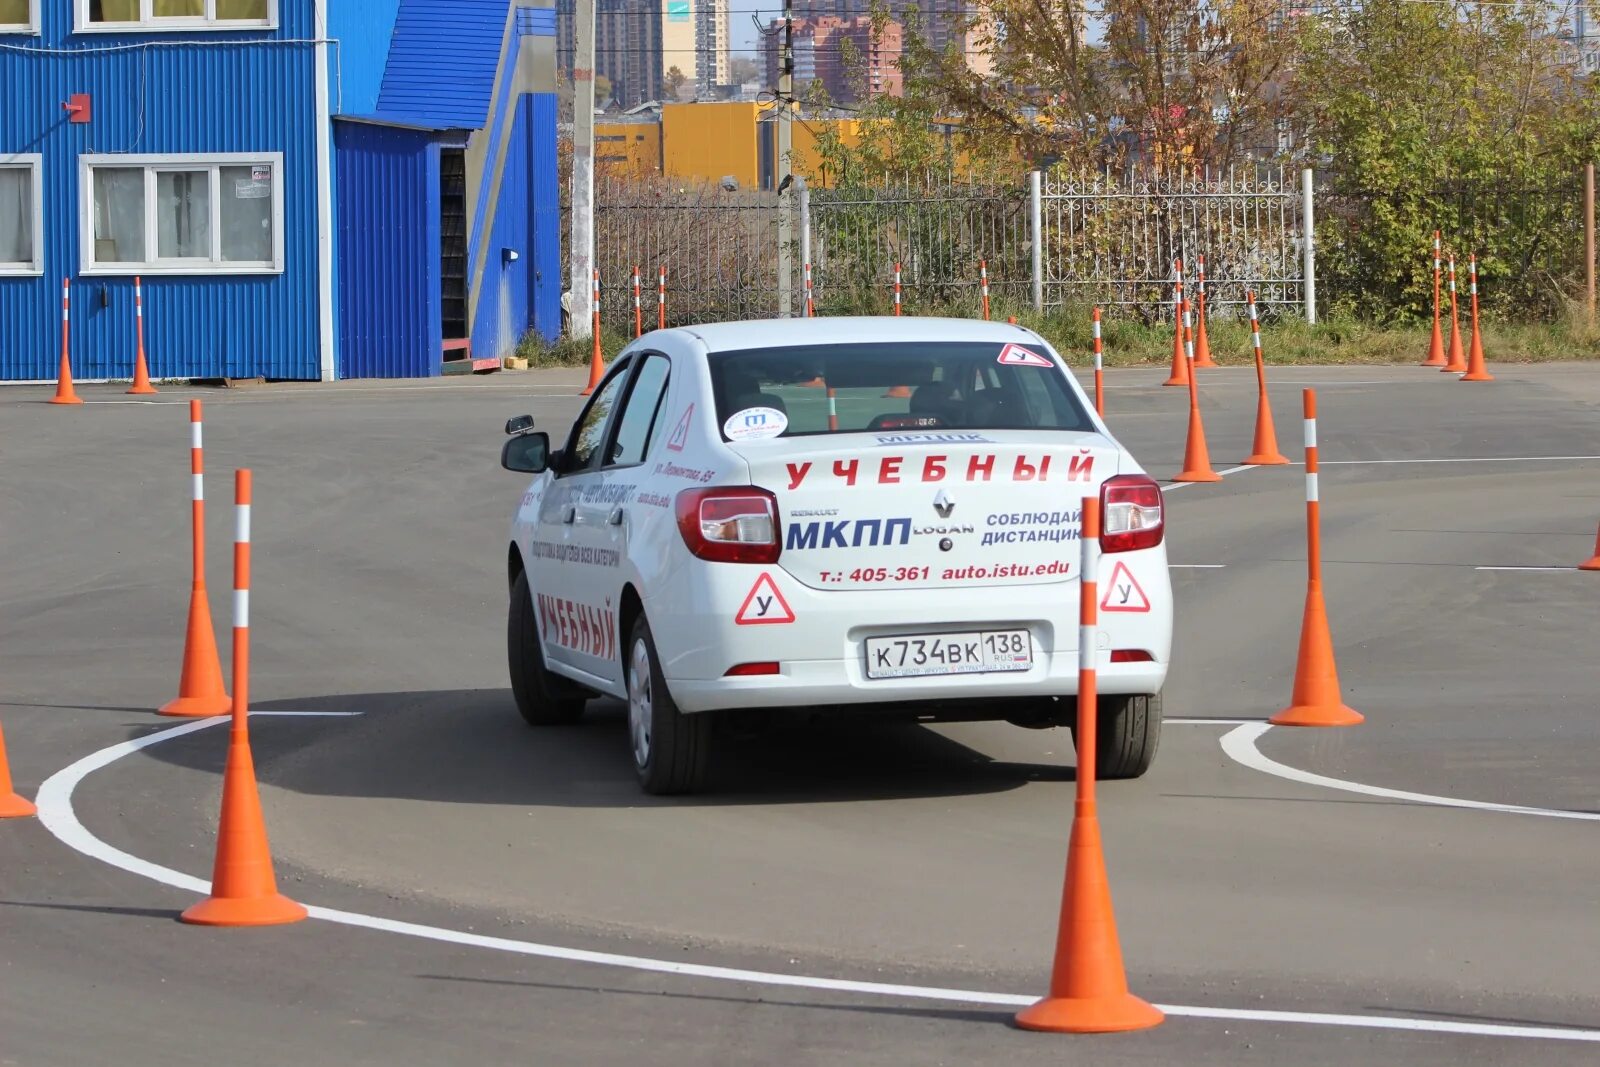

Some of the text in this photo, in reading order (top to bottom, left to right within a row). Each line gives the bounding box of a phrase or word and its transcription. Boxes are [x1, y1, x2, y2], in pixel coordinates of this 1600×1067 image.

[786, 449, 1094, 490] УЧЕБНЫЙ
[790, 508, 840, 517] RENAULT
[986, 508, 1082, 526] СОБЛЮДАЙ
[785, 518, 912, 550] МКПП
[913, 524, 974, 536] LOGAN
[849, 566, 930, 583] 405-361
[942, 560, 1070, 580] auto.istu.edu
[1117, 584, 1132, 604] У
[756, 595, 773, 616] У
[537, 592, 616, 662] УЧЕБНЫЙ
[877, 638, 980, 668] К734ВК
[985, 634, 1023, 654] 138
